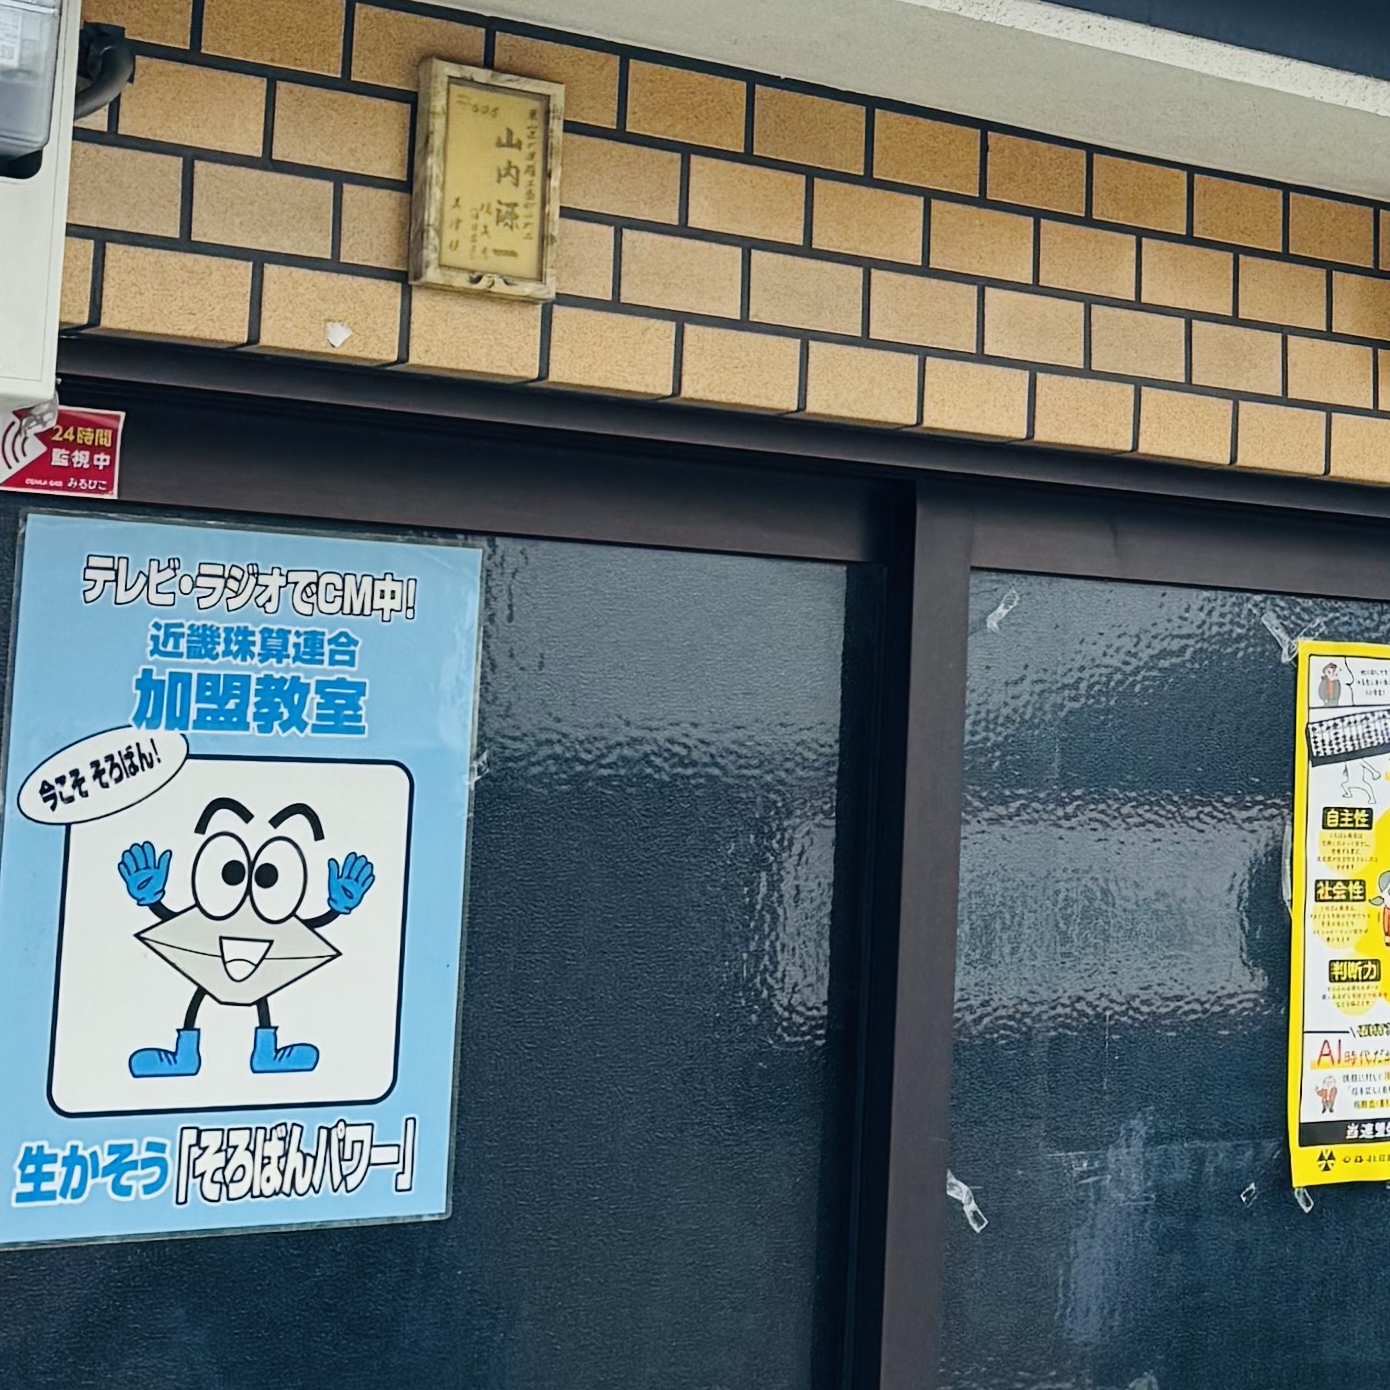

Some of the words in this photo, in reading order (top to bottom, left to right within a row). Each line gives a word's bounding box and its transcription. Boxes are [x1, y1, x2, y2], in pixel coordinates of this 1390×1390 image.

[52, 425, 112, 447] 24時間
[51, 448, 110, 469] 監視中
[149, 622, 360, 669] 近畿珠算連合
[133, 669, 367, 735] 加盟教室
[39, 767, 89, 810] 今こそ
[91, 738, 161, 790] そろばん!
[1326, 810, 1369, 828] 自主性
[1316, 882, 1364, 900] 社会性
[1331, 962, 1379, 980] 判断力
[15, 1140, 169, 1203] 生かそう
